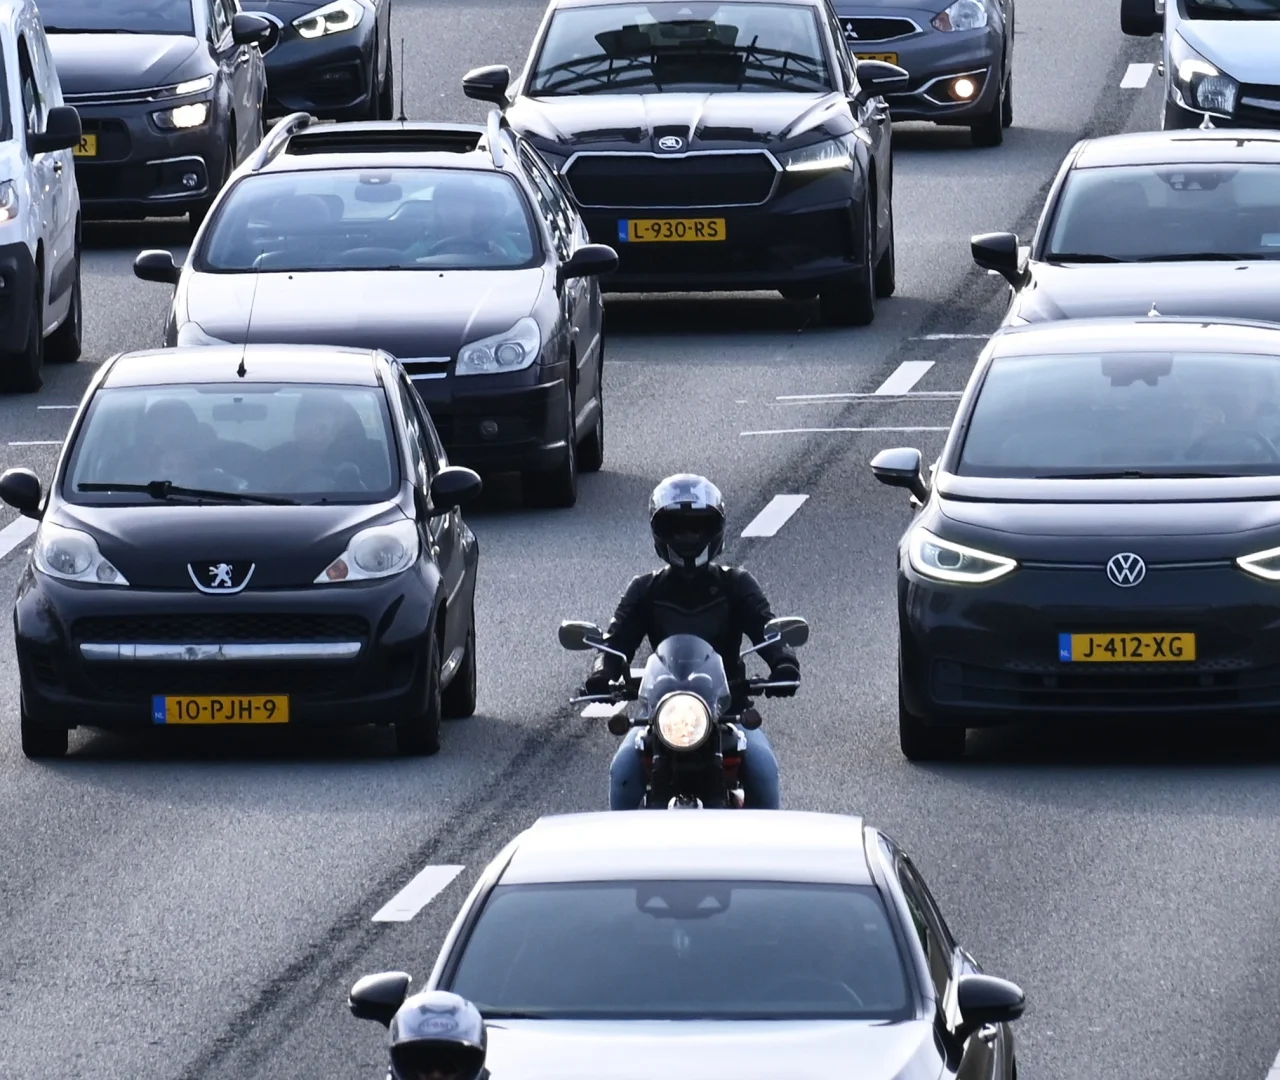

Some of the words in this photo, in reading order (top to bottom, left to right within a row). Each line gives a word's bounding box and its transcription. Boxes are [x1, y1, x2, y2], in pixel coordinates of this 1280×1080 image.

[634, 221, 718, 239] L-930-RS
[1084, 637, 1184, 658] J-412-XG
[175, 699, 277, 721] 10-PJH-9
